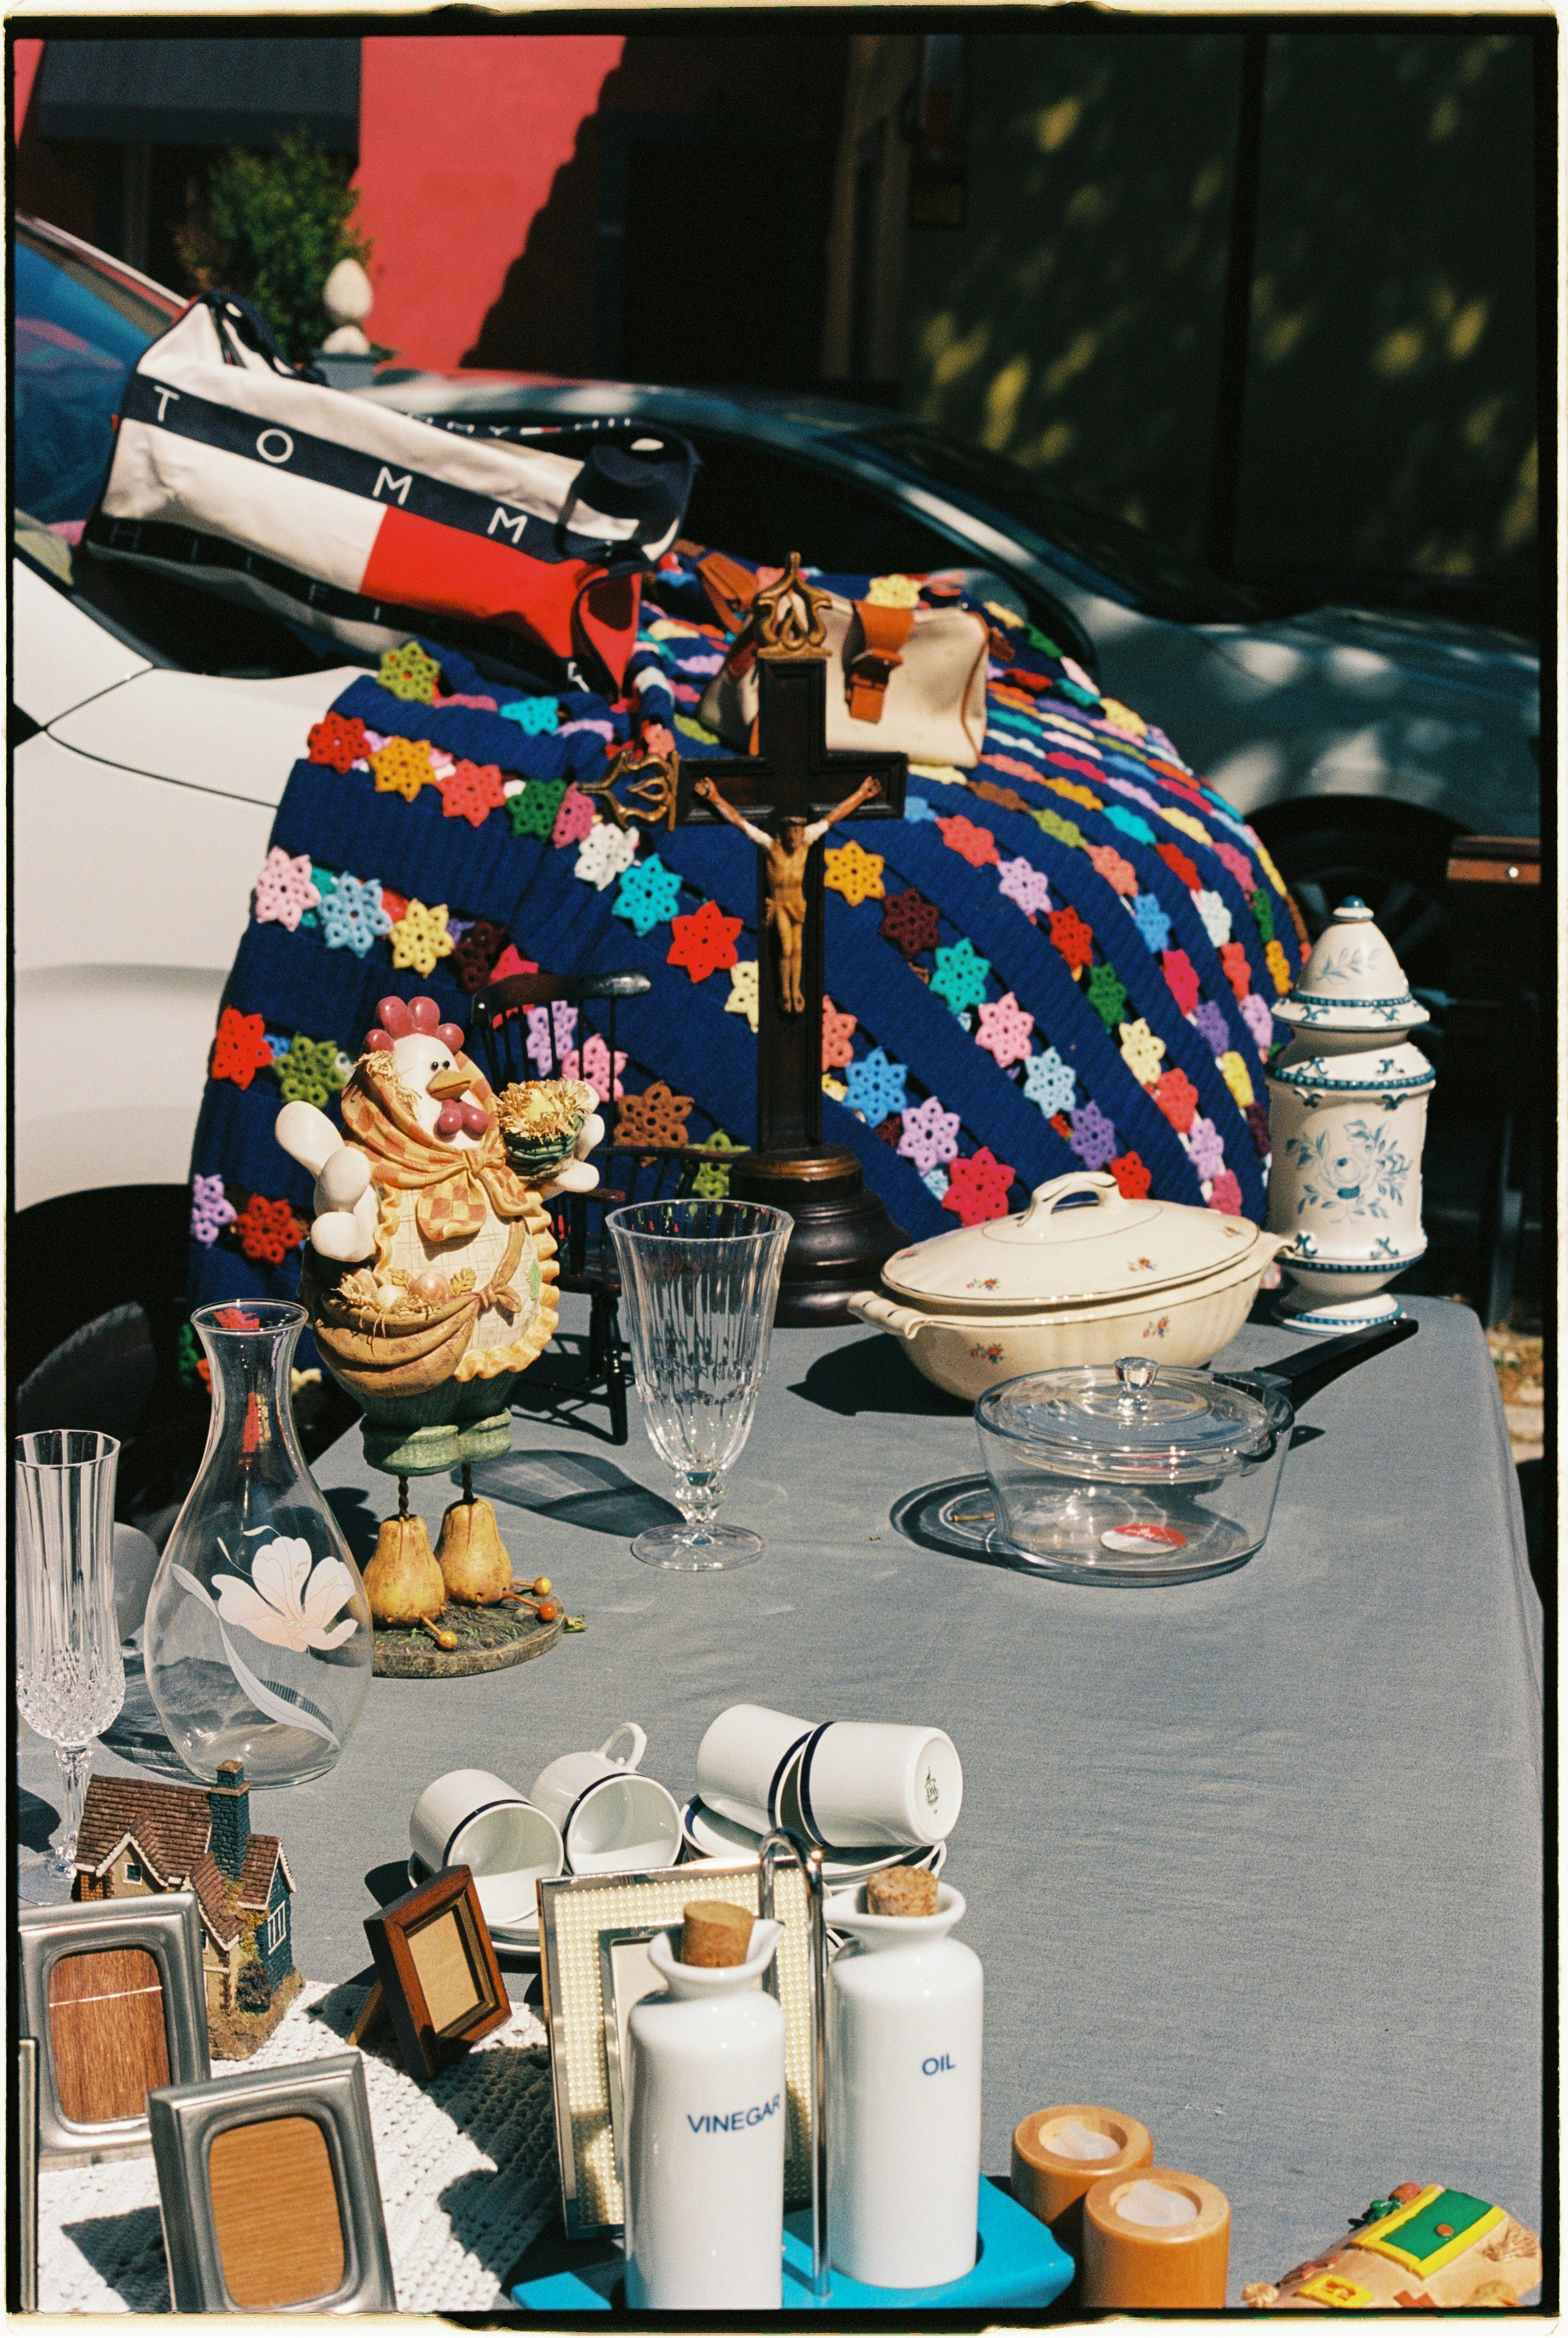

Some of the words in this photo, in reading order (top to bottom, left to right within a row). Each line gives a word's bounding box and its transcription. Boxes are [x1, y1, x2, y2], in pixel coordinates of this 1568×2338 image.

[154, 385, 612, 557] TOMM
[921, 2052, 956, 2076] OIL
[686, 2093, 781, 2134] VINEGAR
